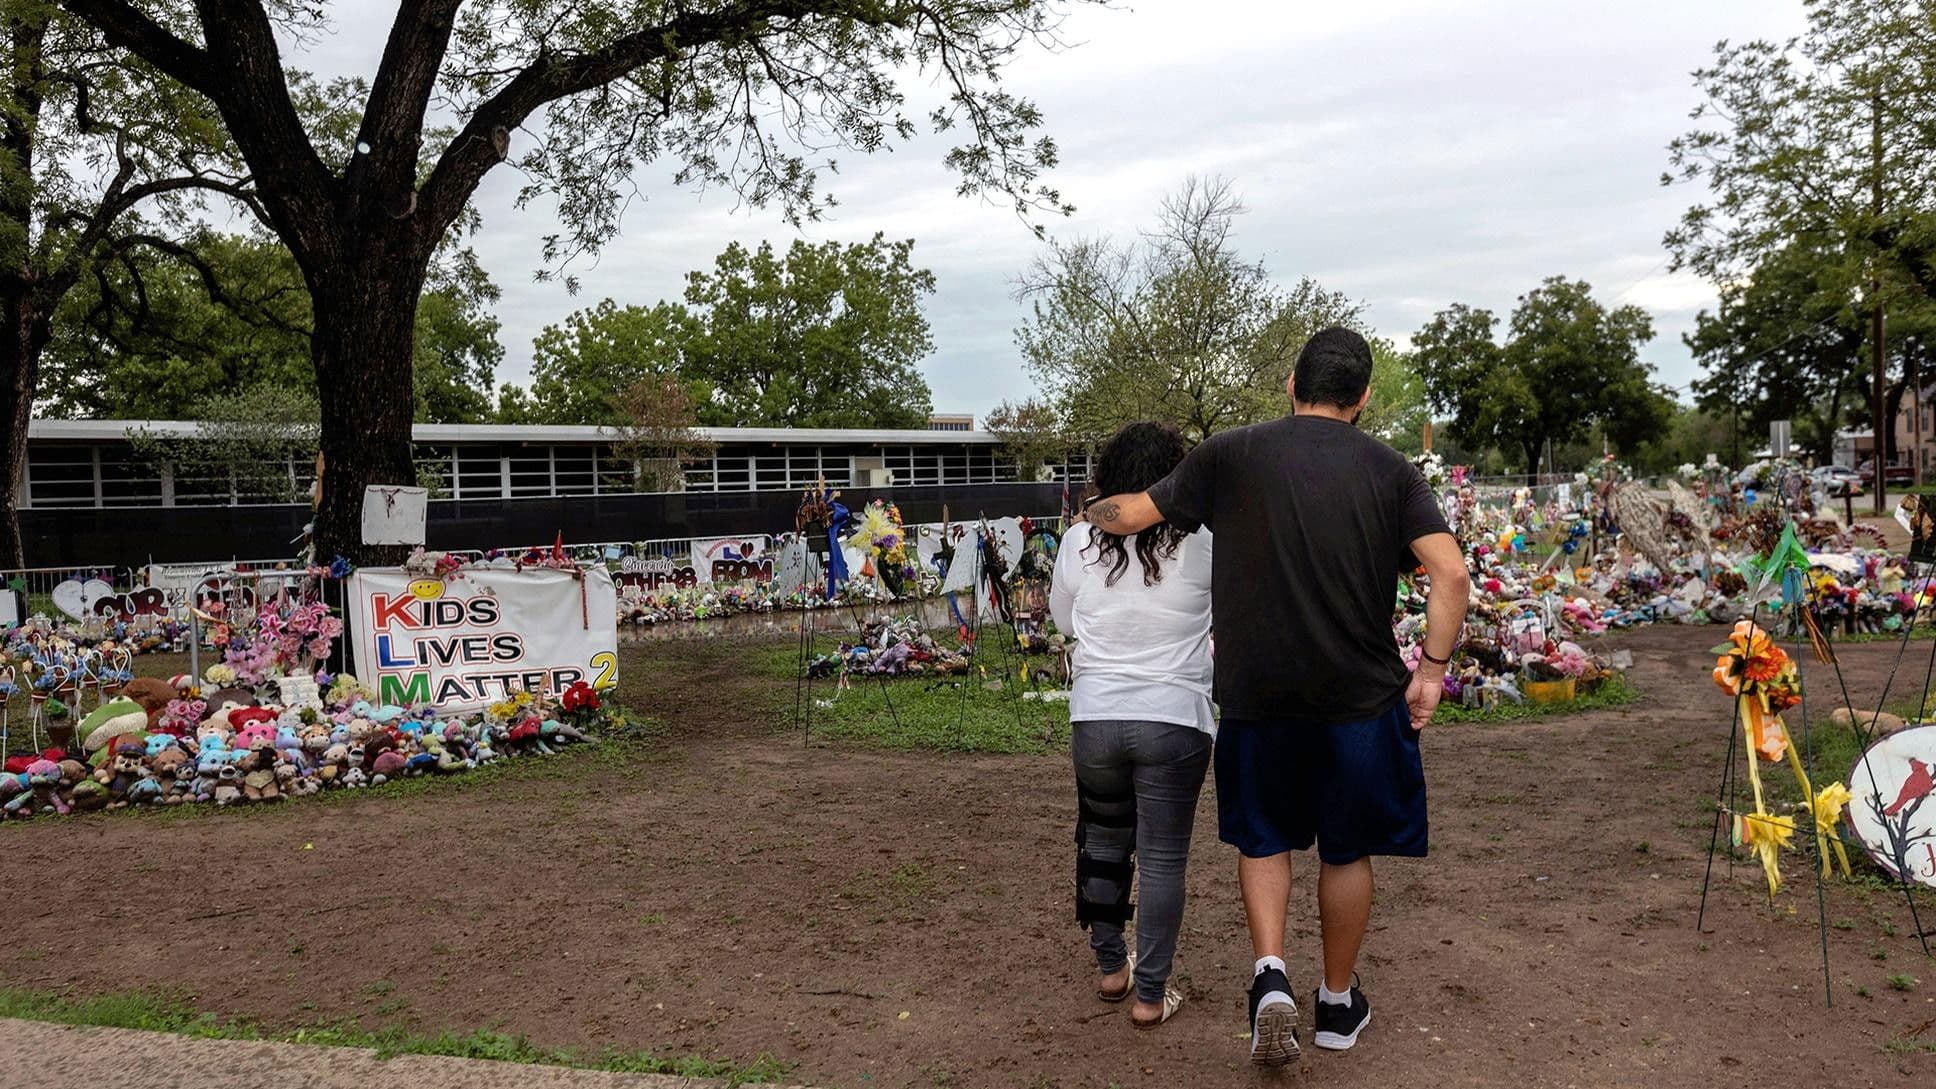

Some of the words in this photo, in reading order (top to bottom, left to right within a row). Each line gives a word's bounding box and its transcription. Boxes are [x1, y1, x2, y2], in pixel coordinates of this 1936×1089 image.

[711, 560, 774, 582] FROM
[94, 588, 168, 624] OUR
[373, 594, 499, 630] KIDS
[376, 633, 523, 668] LIVES
[379, 669, 584, 705] MATTER
[590, 652, 617, 690] 2
